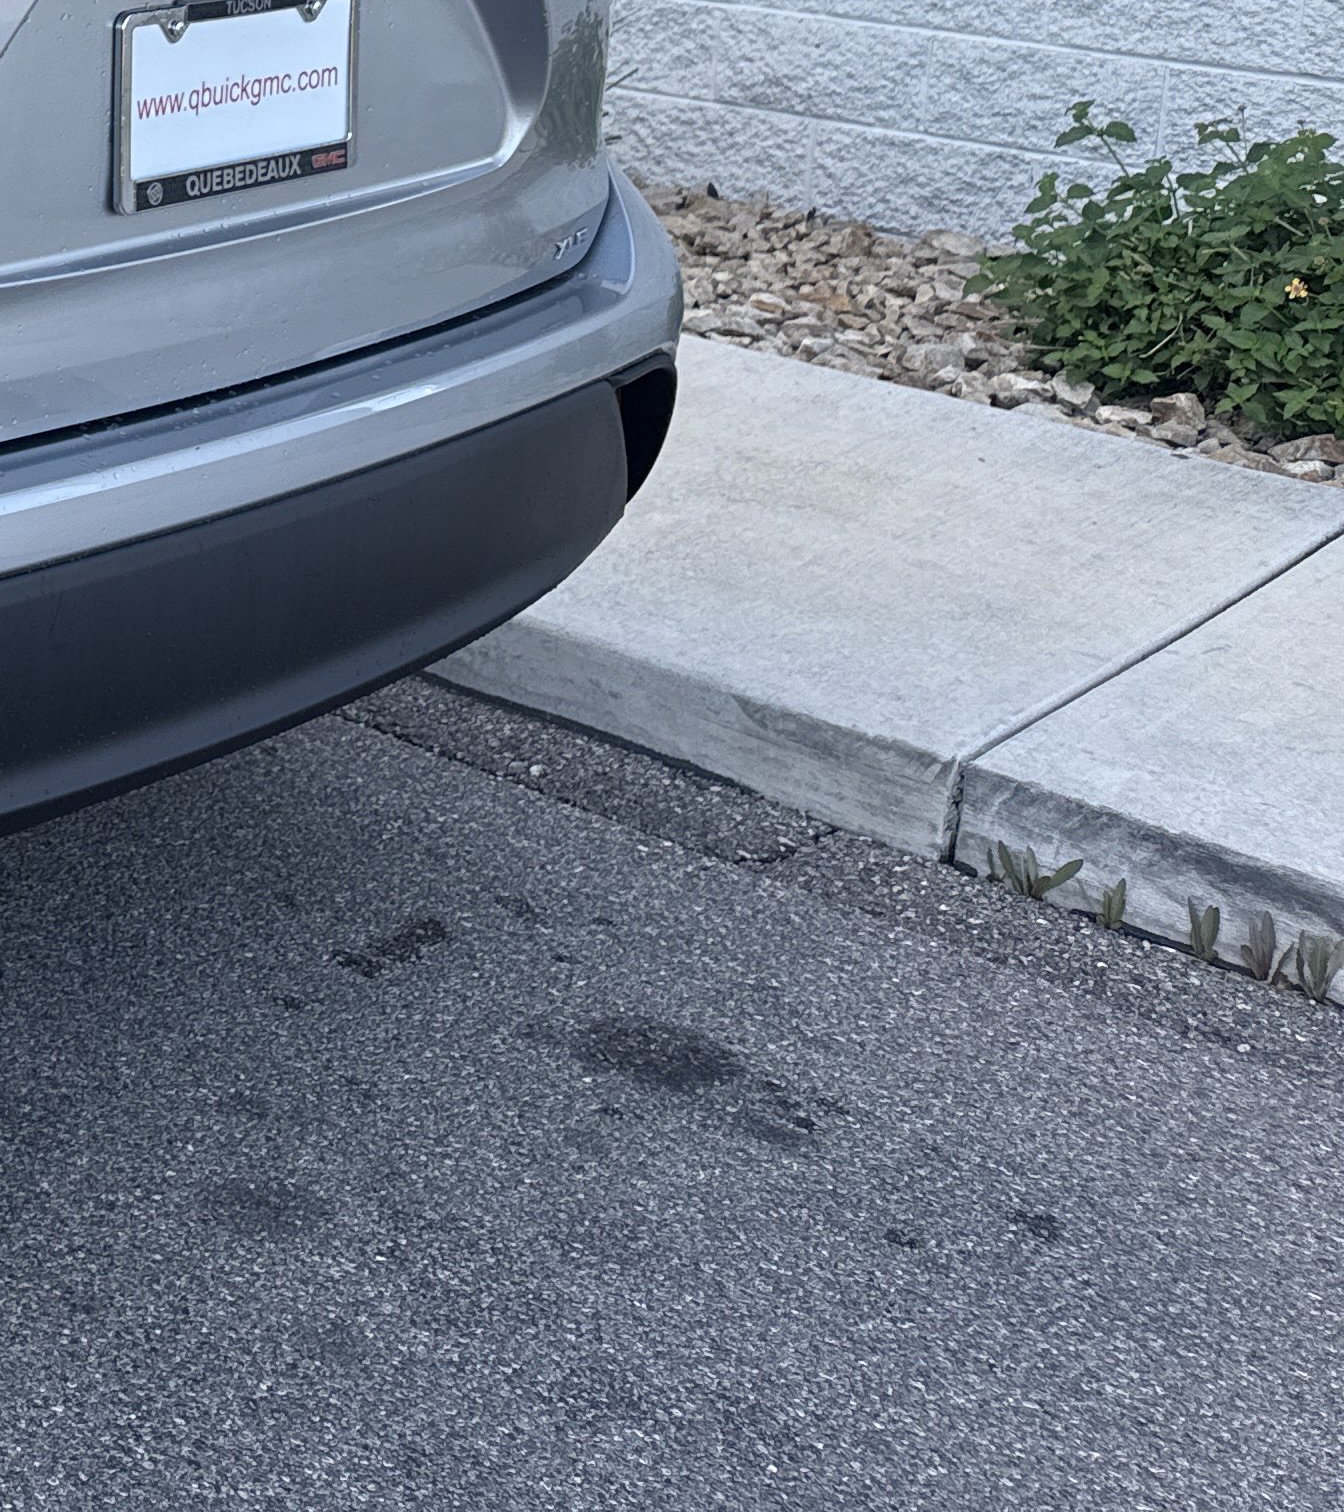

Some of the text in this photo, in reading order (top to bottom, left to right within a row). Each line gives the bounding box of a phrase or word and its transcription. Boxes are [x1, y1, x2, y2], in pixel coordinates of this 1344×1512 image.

[136, 65, 339, 120] www.qbuickgmc.com
[185, 148, 346, 198] QUEBEDEAUX GMC
